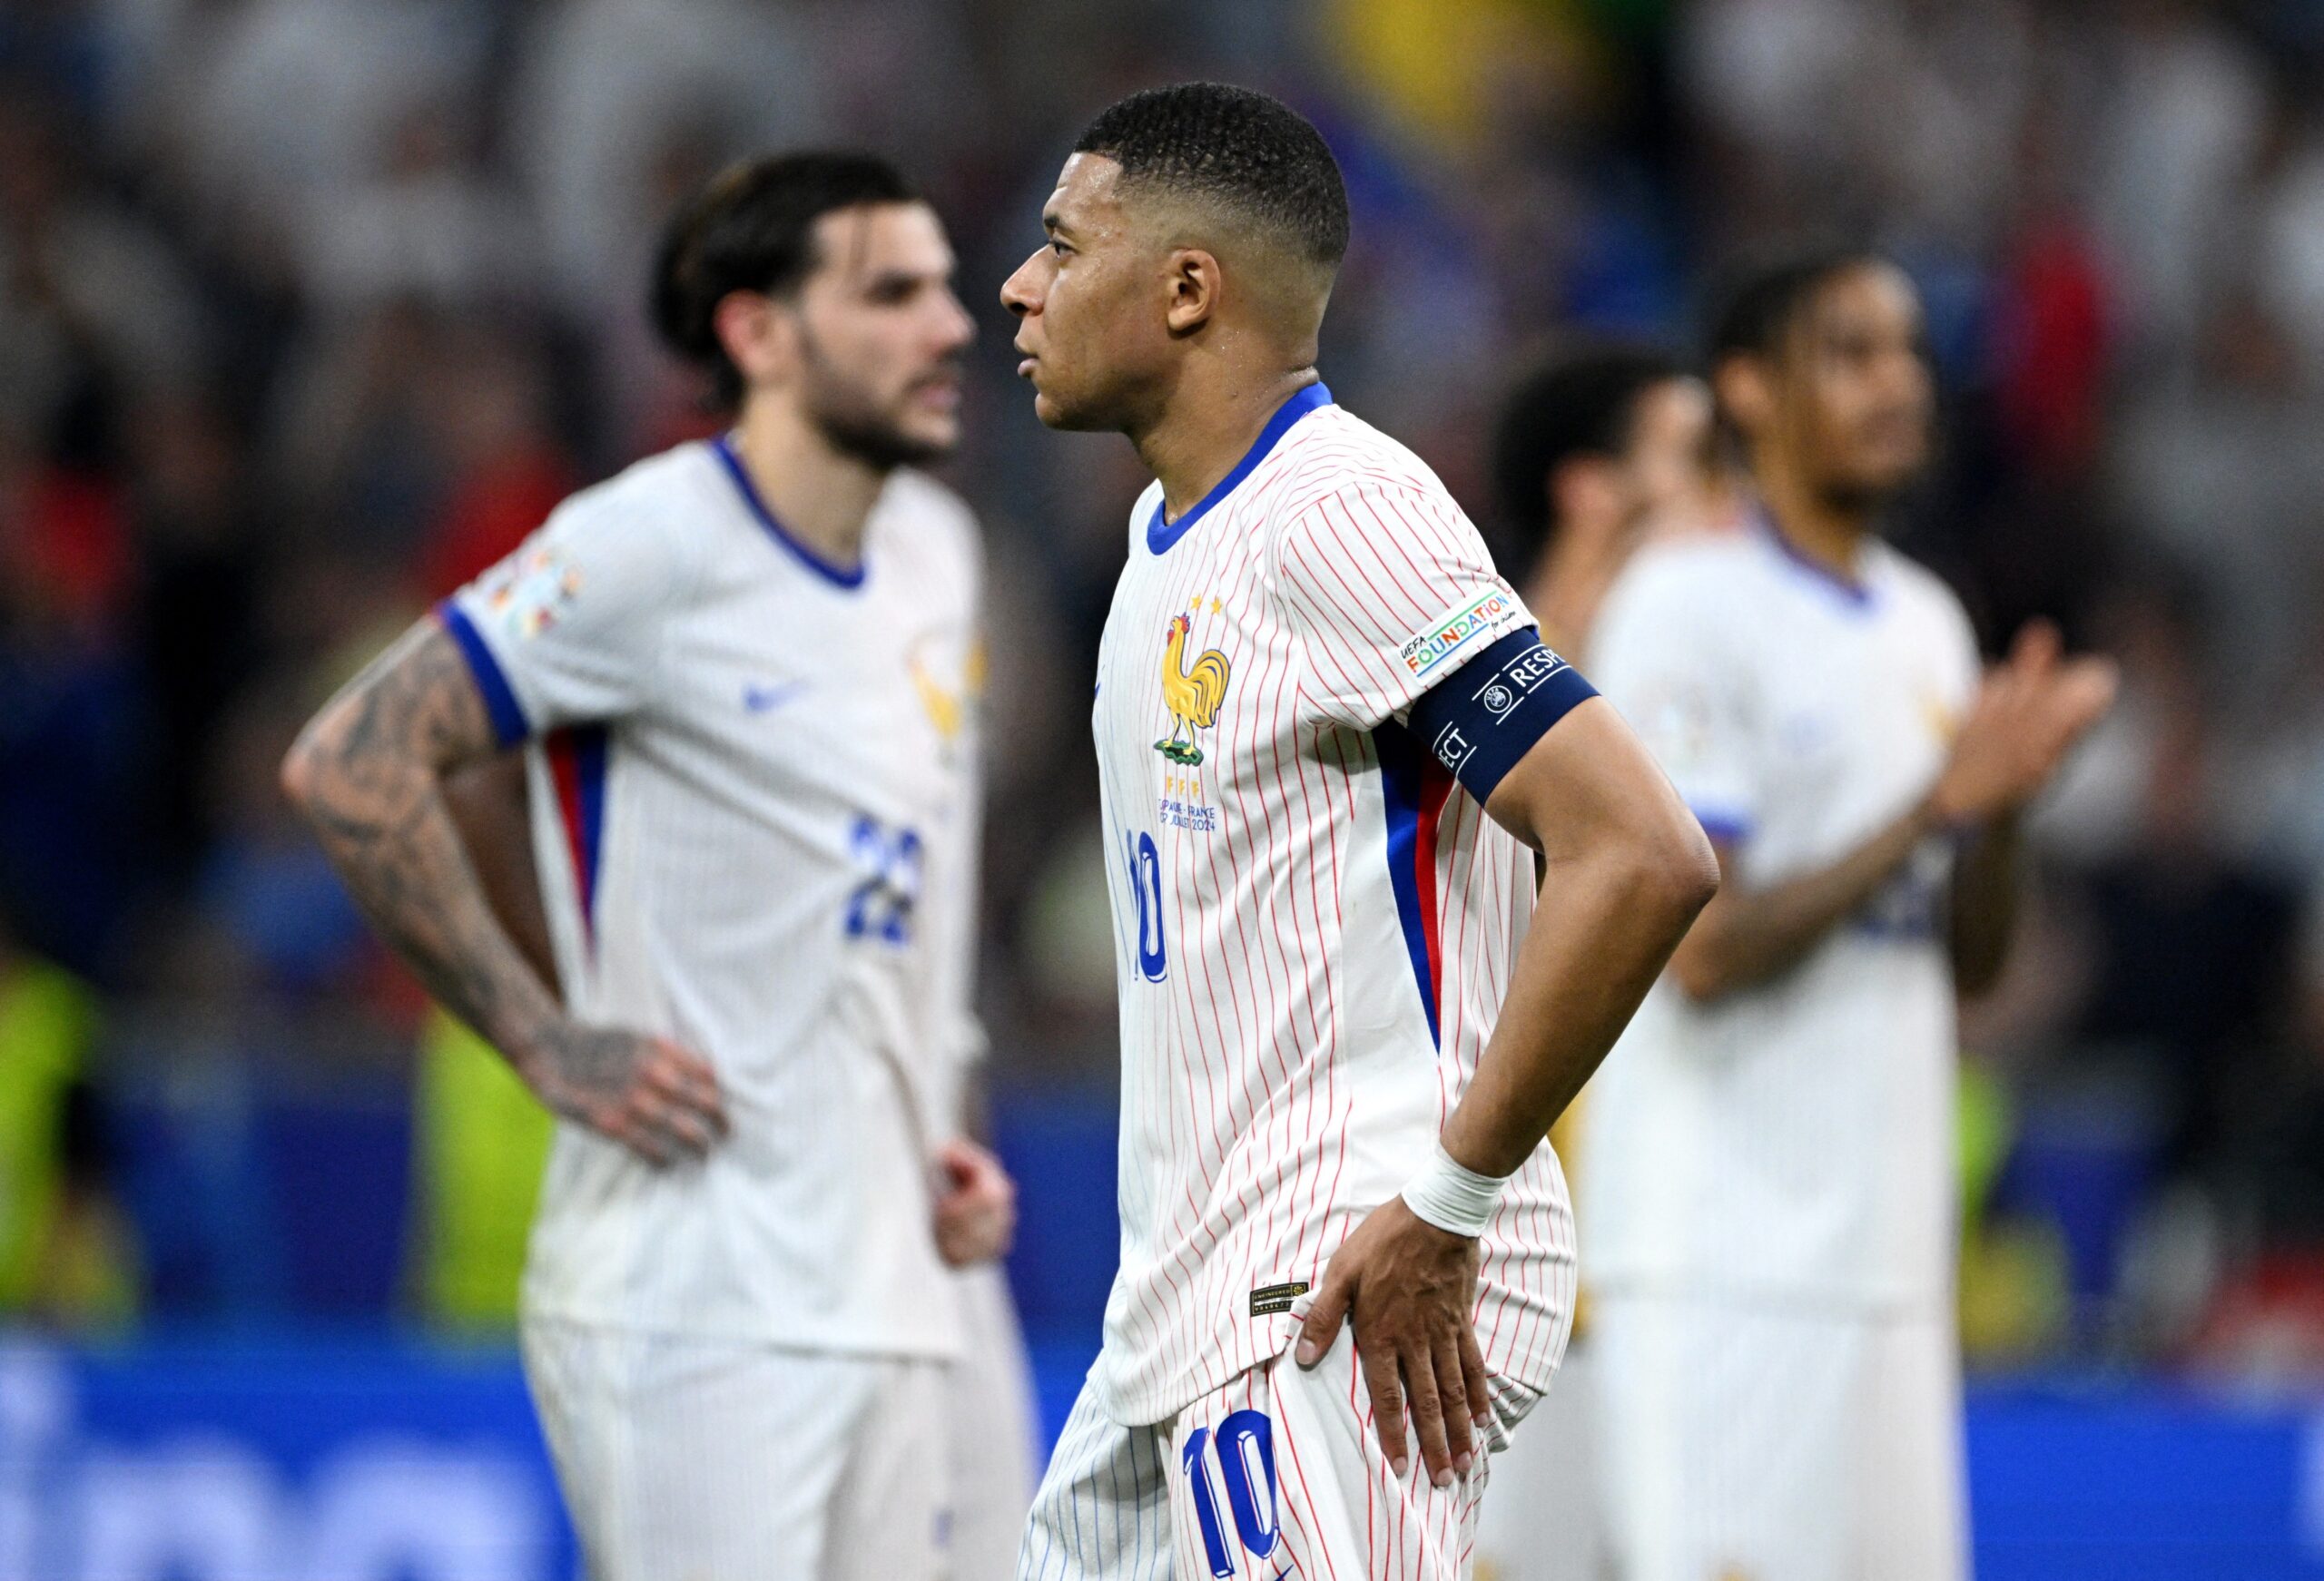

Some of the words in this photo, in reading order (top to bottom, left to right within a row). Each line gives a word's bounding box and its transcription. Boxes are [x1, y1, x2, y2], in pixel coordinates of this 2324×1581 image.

[1401, 635, 1426, 659] UEFA
[1187, 805, 1215, 820] FRANCE
[1192, 819, 1216, 831] 2024
[1127, 829, 1167, 983] 10
[1183, 1409, 1280, 1579] 10
